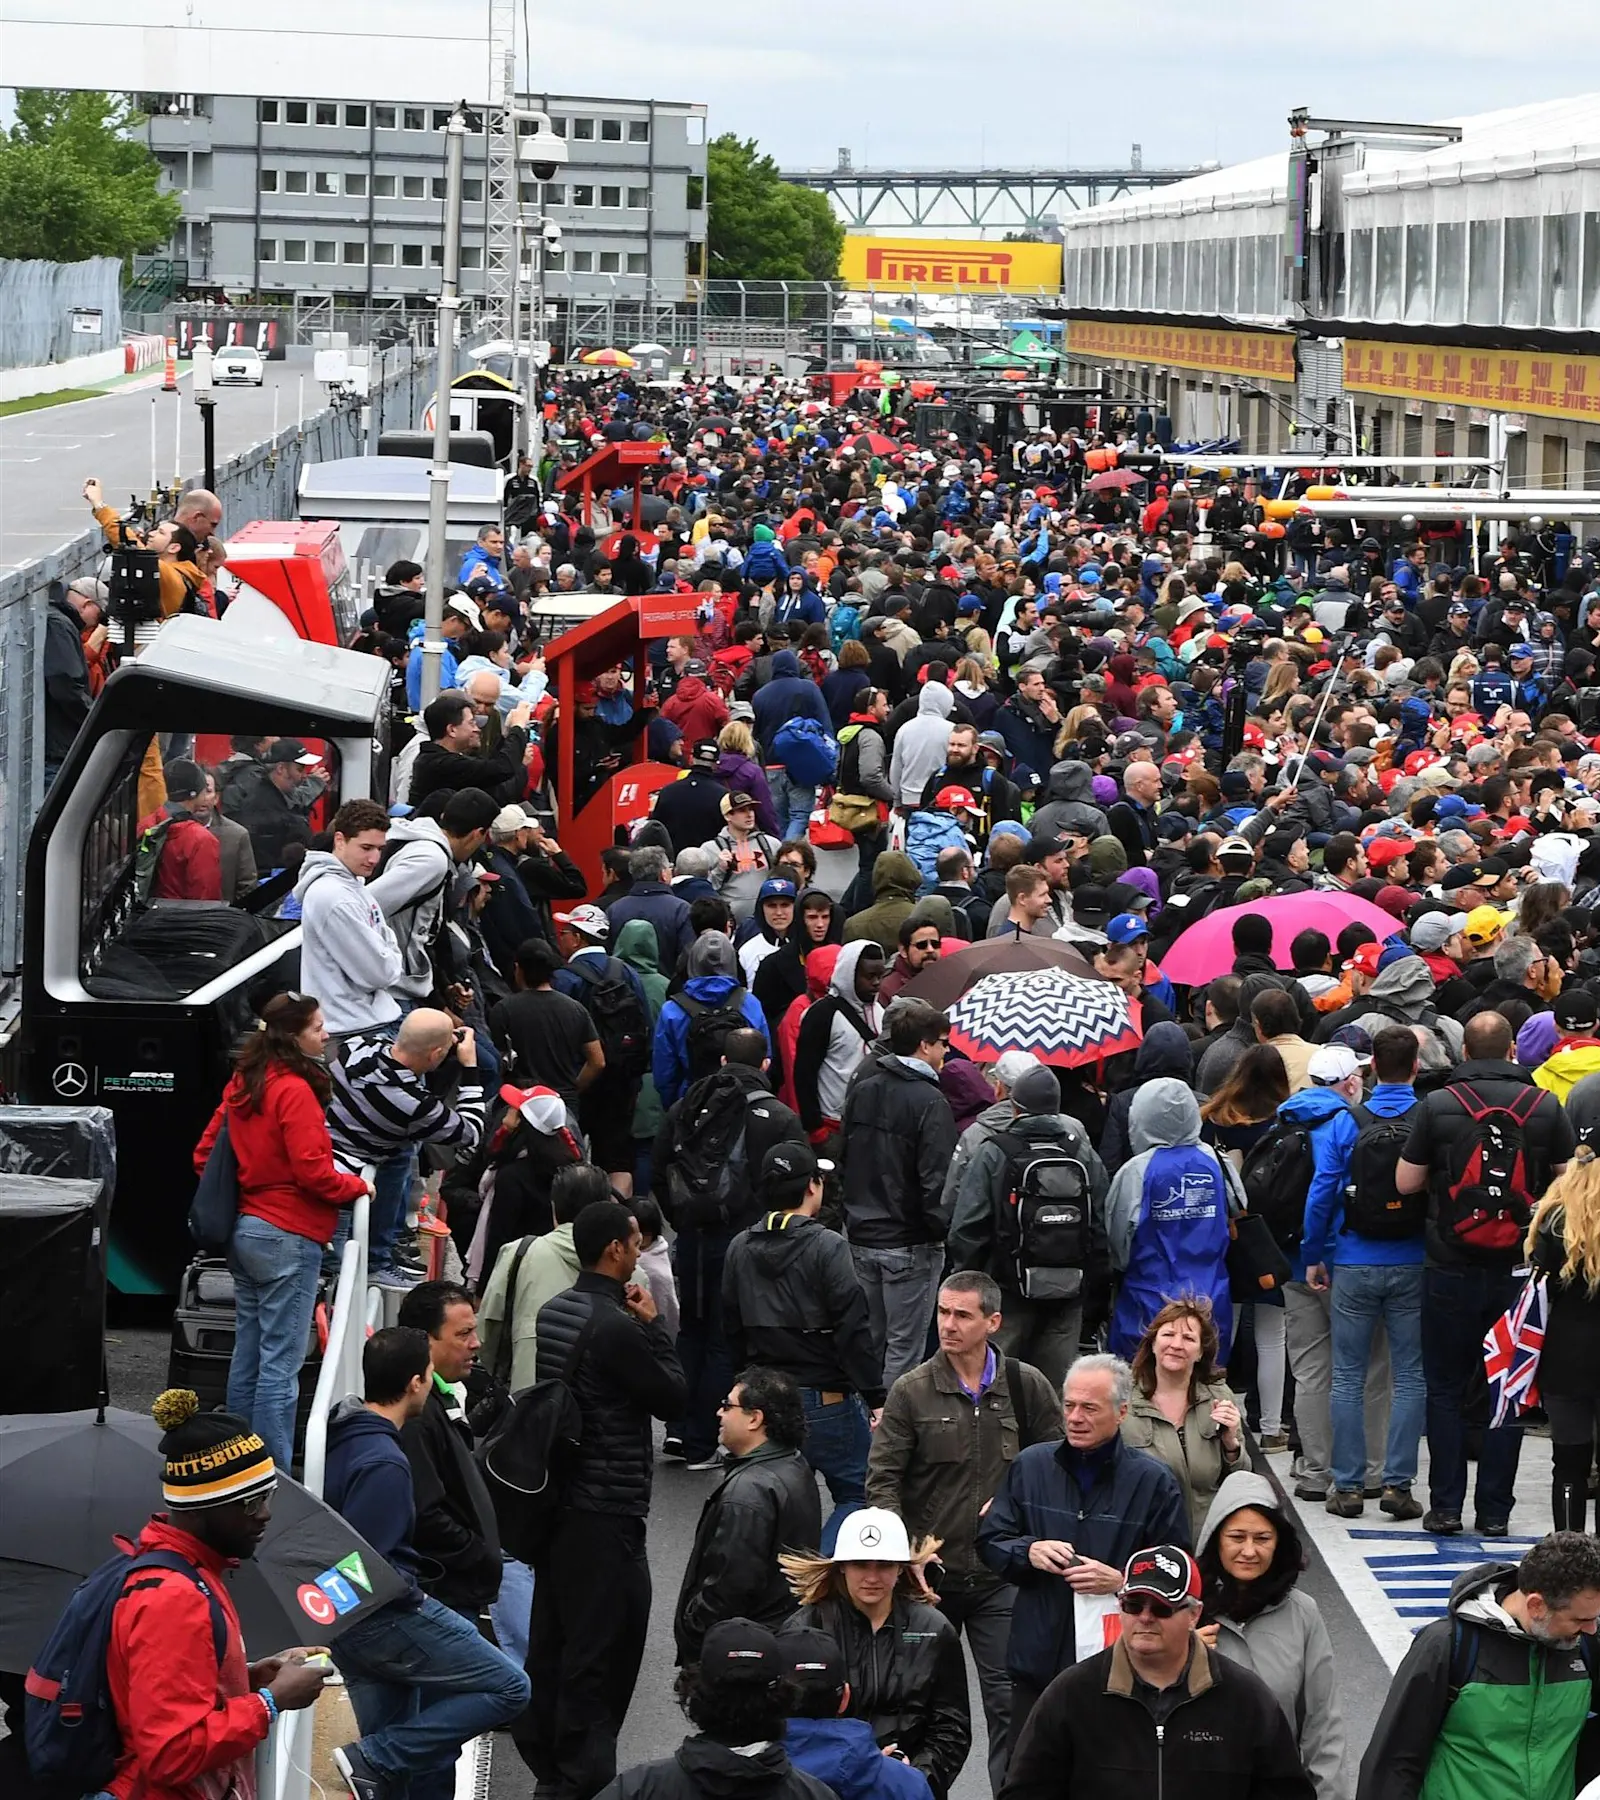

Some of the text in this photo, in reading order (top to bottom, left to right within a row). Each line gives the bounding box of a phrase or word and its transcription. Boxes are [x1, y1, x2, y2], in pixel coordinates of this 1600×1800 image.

[866, 248, 1012, 284] PIRELLI
[1531, 361, 1553, 405] DHL
[1563, 365, 1588, 409] DHL
[585, 911, 595, 922] 2
[103, 1077, 174, 1087] PETRONAS
[1042, 1214, 1068, 1222] CRAFT
[1132, 1561, 1155, 1575] gpc
[302, 1552, 372, 1622] CTV
